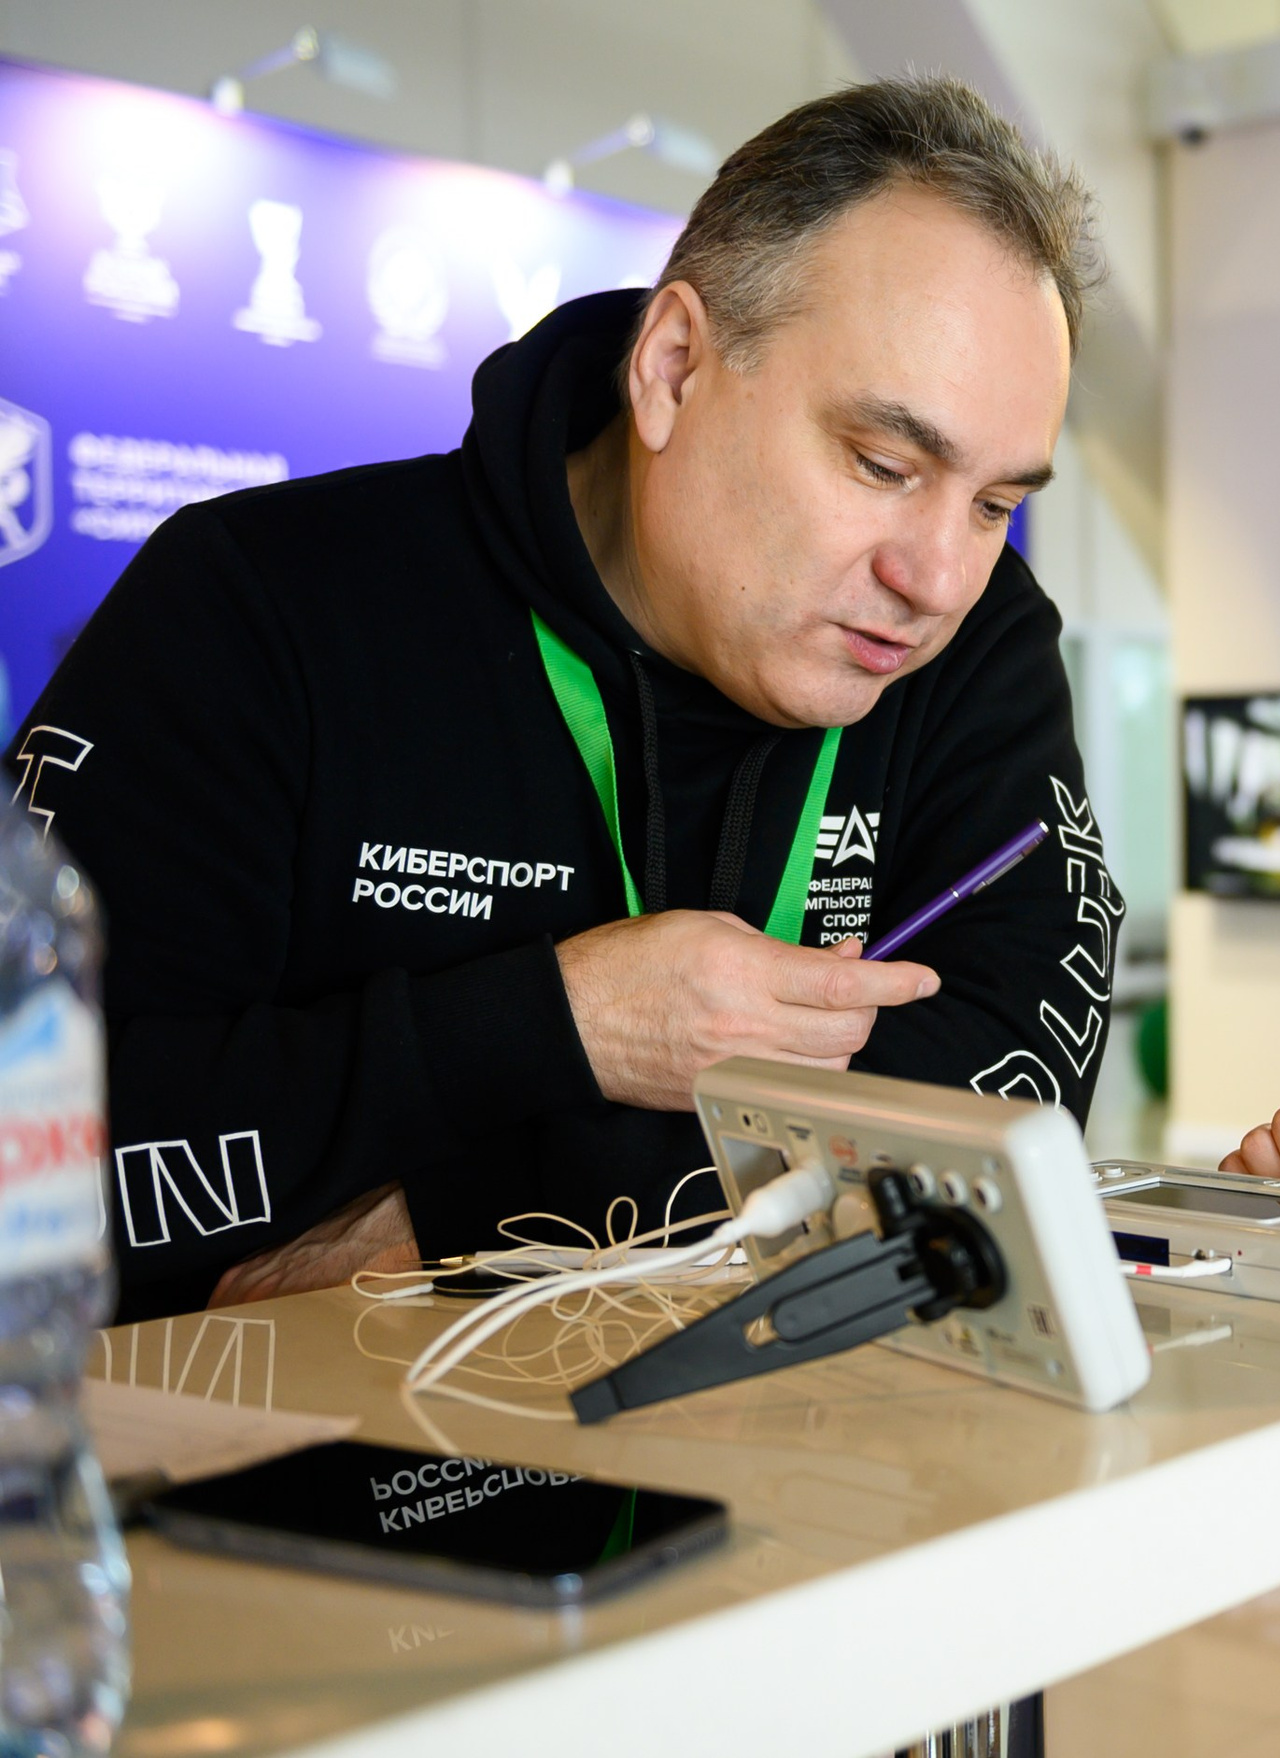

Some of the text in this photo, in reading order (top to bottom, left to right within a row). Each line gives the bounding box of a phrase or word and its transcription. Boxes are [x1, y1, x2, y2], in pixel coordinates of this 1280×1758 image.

[358, 841, 576, 892] КИБЕРСПОРТ
[352, 877, 494, 921] РОССИИ
[804, 895, 872, 910] МПЬЮТЕ
[822, 913, 871, 928] СПОРТ
